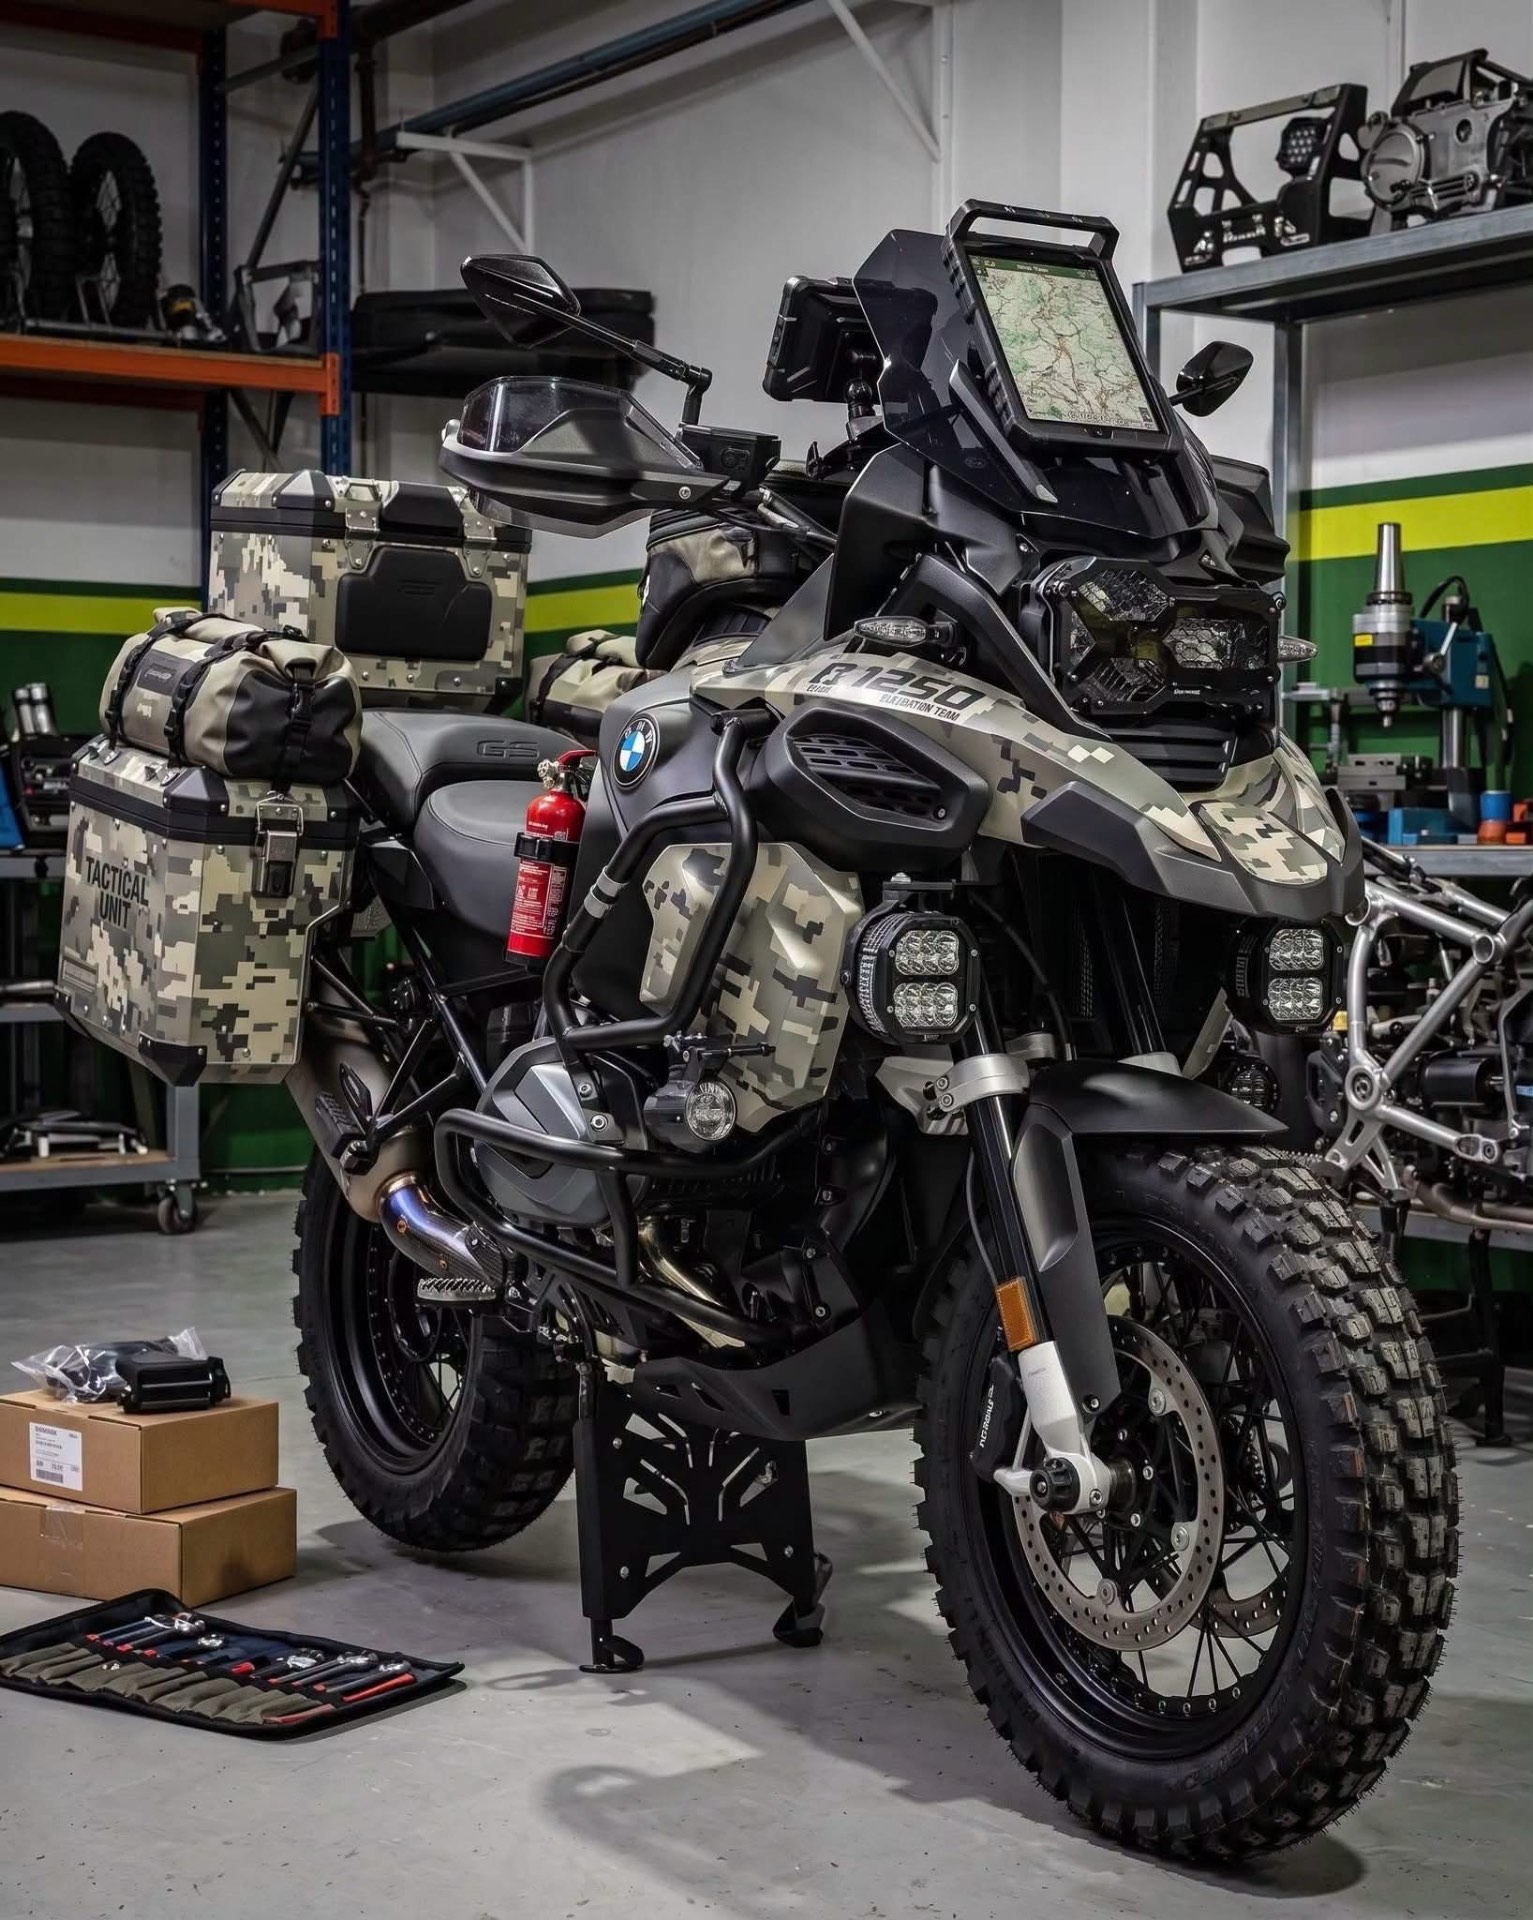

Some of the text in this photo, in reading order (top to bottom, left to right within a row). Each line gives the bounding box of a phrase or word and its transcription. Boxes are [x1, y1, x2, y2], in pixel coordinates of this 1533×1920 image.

[850, 665, 987, 711] 1250
[933, 706, 961, 721] TEAM
[477, 740, 540, 758] GS
[86, 855, 149, 907] TACTICAL
[100, 891, 131, 929] UNIT
